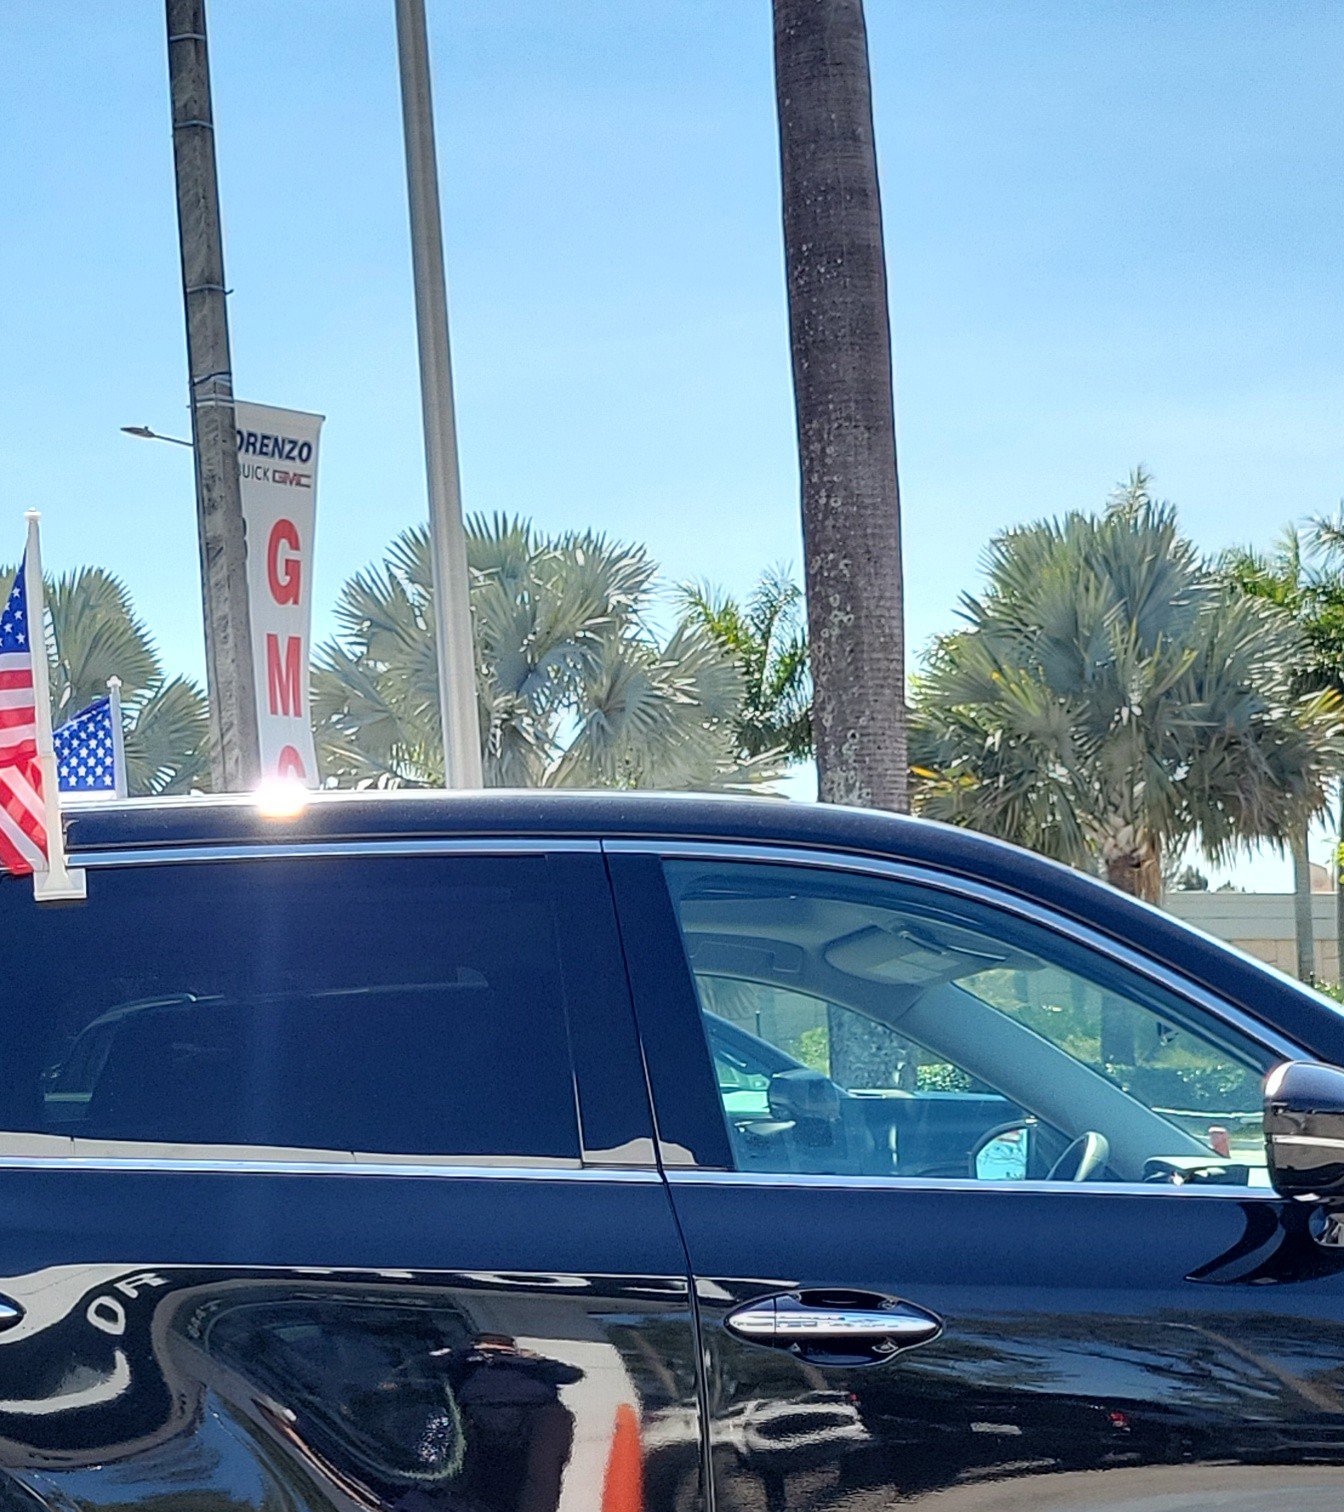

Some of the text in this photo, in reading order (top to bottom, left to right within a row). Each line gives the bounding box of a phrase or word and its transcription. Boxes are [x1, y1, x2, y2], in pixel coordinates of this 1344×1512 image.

[236, 429, 312, 463] ORENZO
[239, 463, 312, 489] UICK GMC
